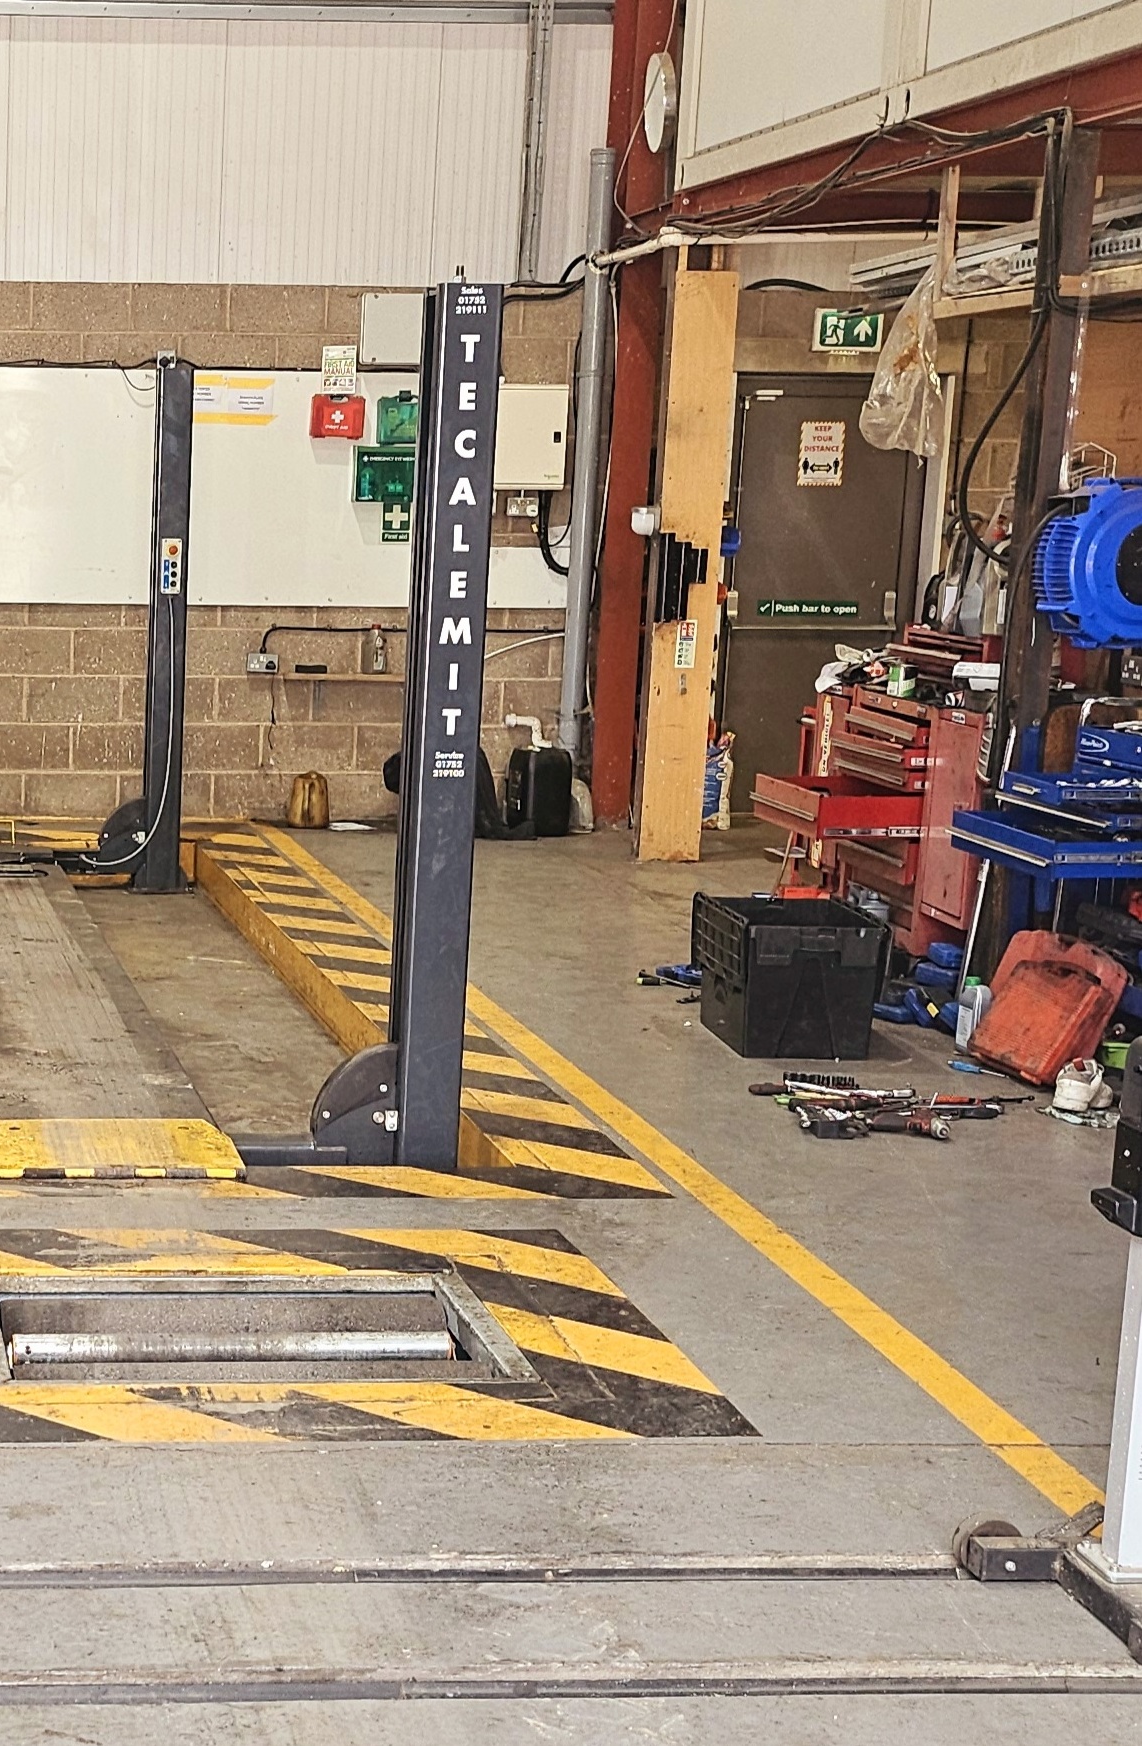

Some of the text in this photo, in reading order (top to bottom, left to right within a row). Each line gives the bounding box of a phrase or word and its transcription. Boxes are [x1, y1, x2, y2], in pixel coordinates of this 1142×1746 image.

[461, 286, 483, 294] Sales
[458, 296, 485, 304] 01752
[455, 305, 487, 314] 219111
[439, 334, 480, 736] TECALEMIT
[775, 603, 857, 616] Push bar to open
[434, 750, 465, 760] Service
[435, 760, 463, 769] 01752
